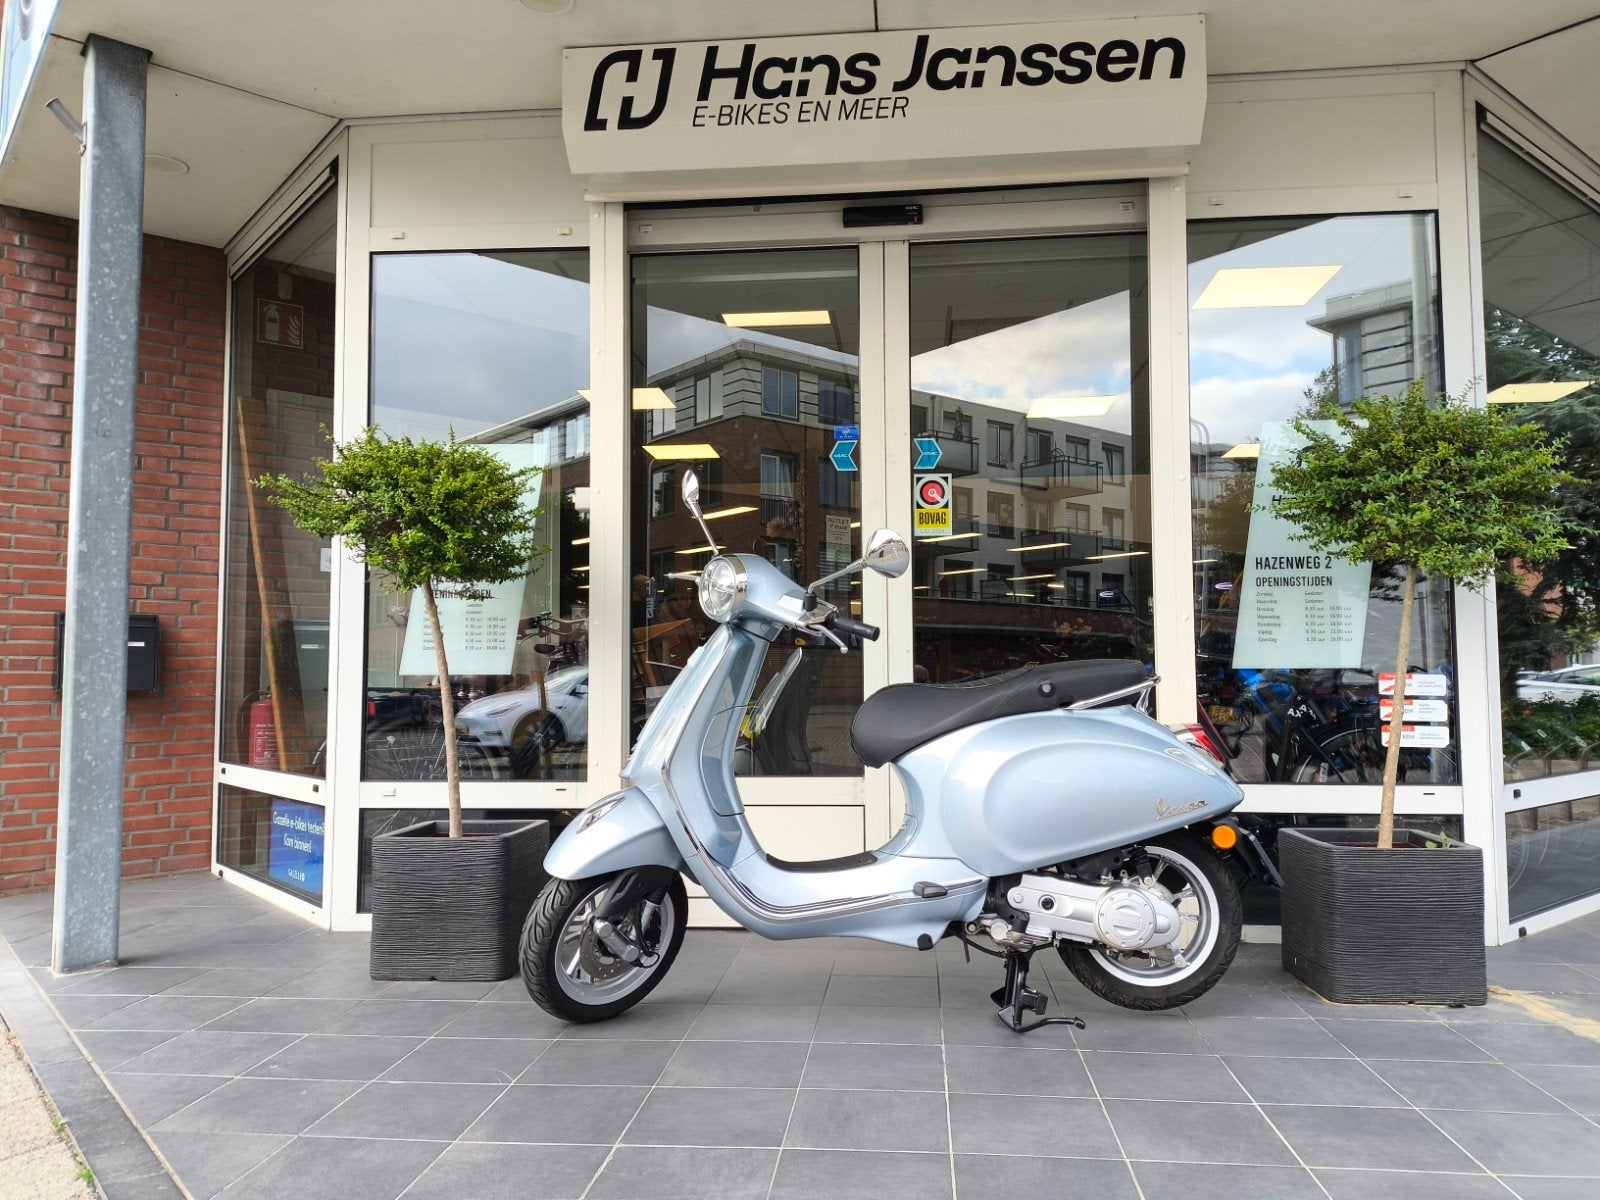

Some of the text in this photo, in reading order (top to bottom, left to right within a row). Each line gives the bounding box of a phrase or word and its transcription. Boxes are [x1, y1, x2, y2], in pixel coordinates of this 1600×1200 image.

[697, 34, 1186, 101] Hans Janssen
[692, 97, 909, 127] E-BIKES EN MEER
[919, 512, 947, 525] BOVAG
[1255, 556, 1332, 570] HAZENWEG 2
[1255, 576, 1333, 587] OPENINGSTIJDEN
